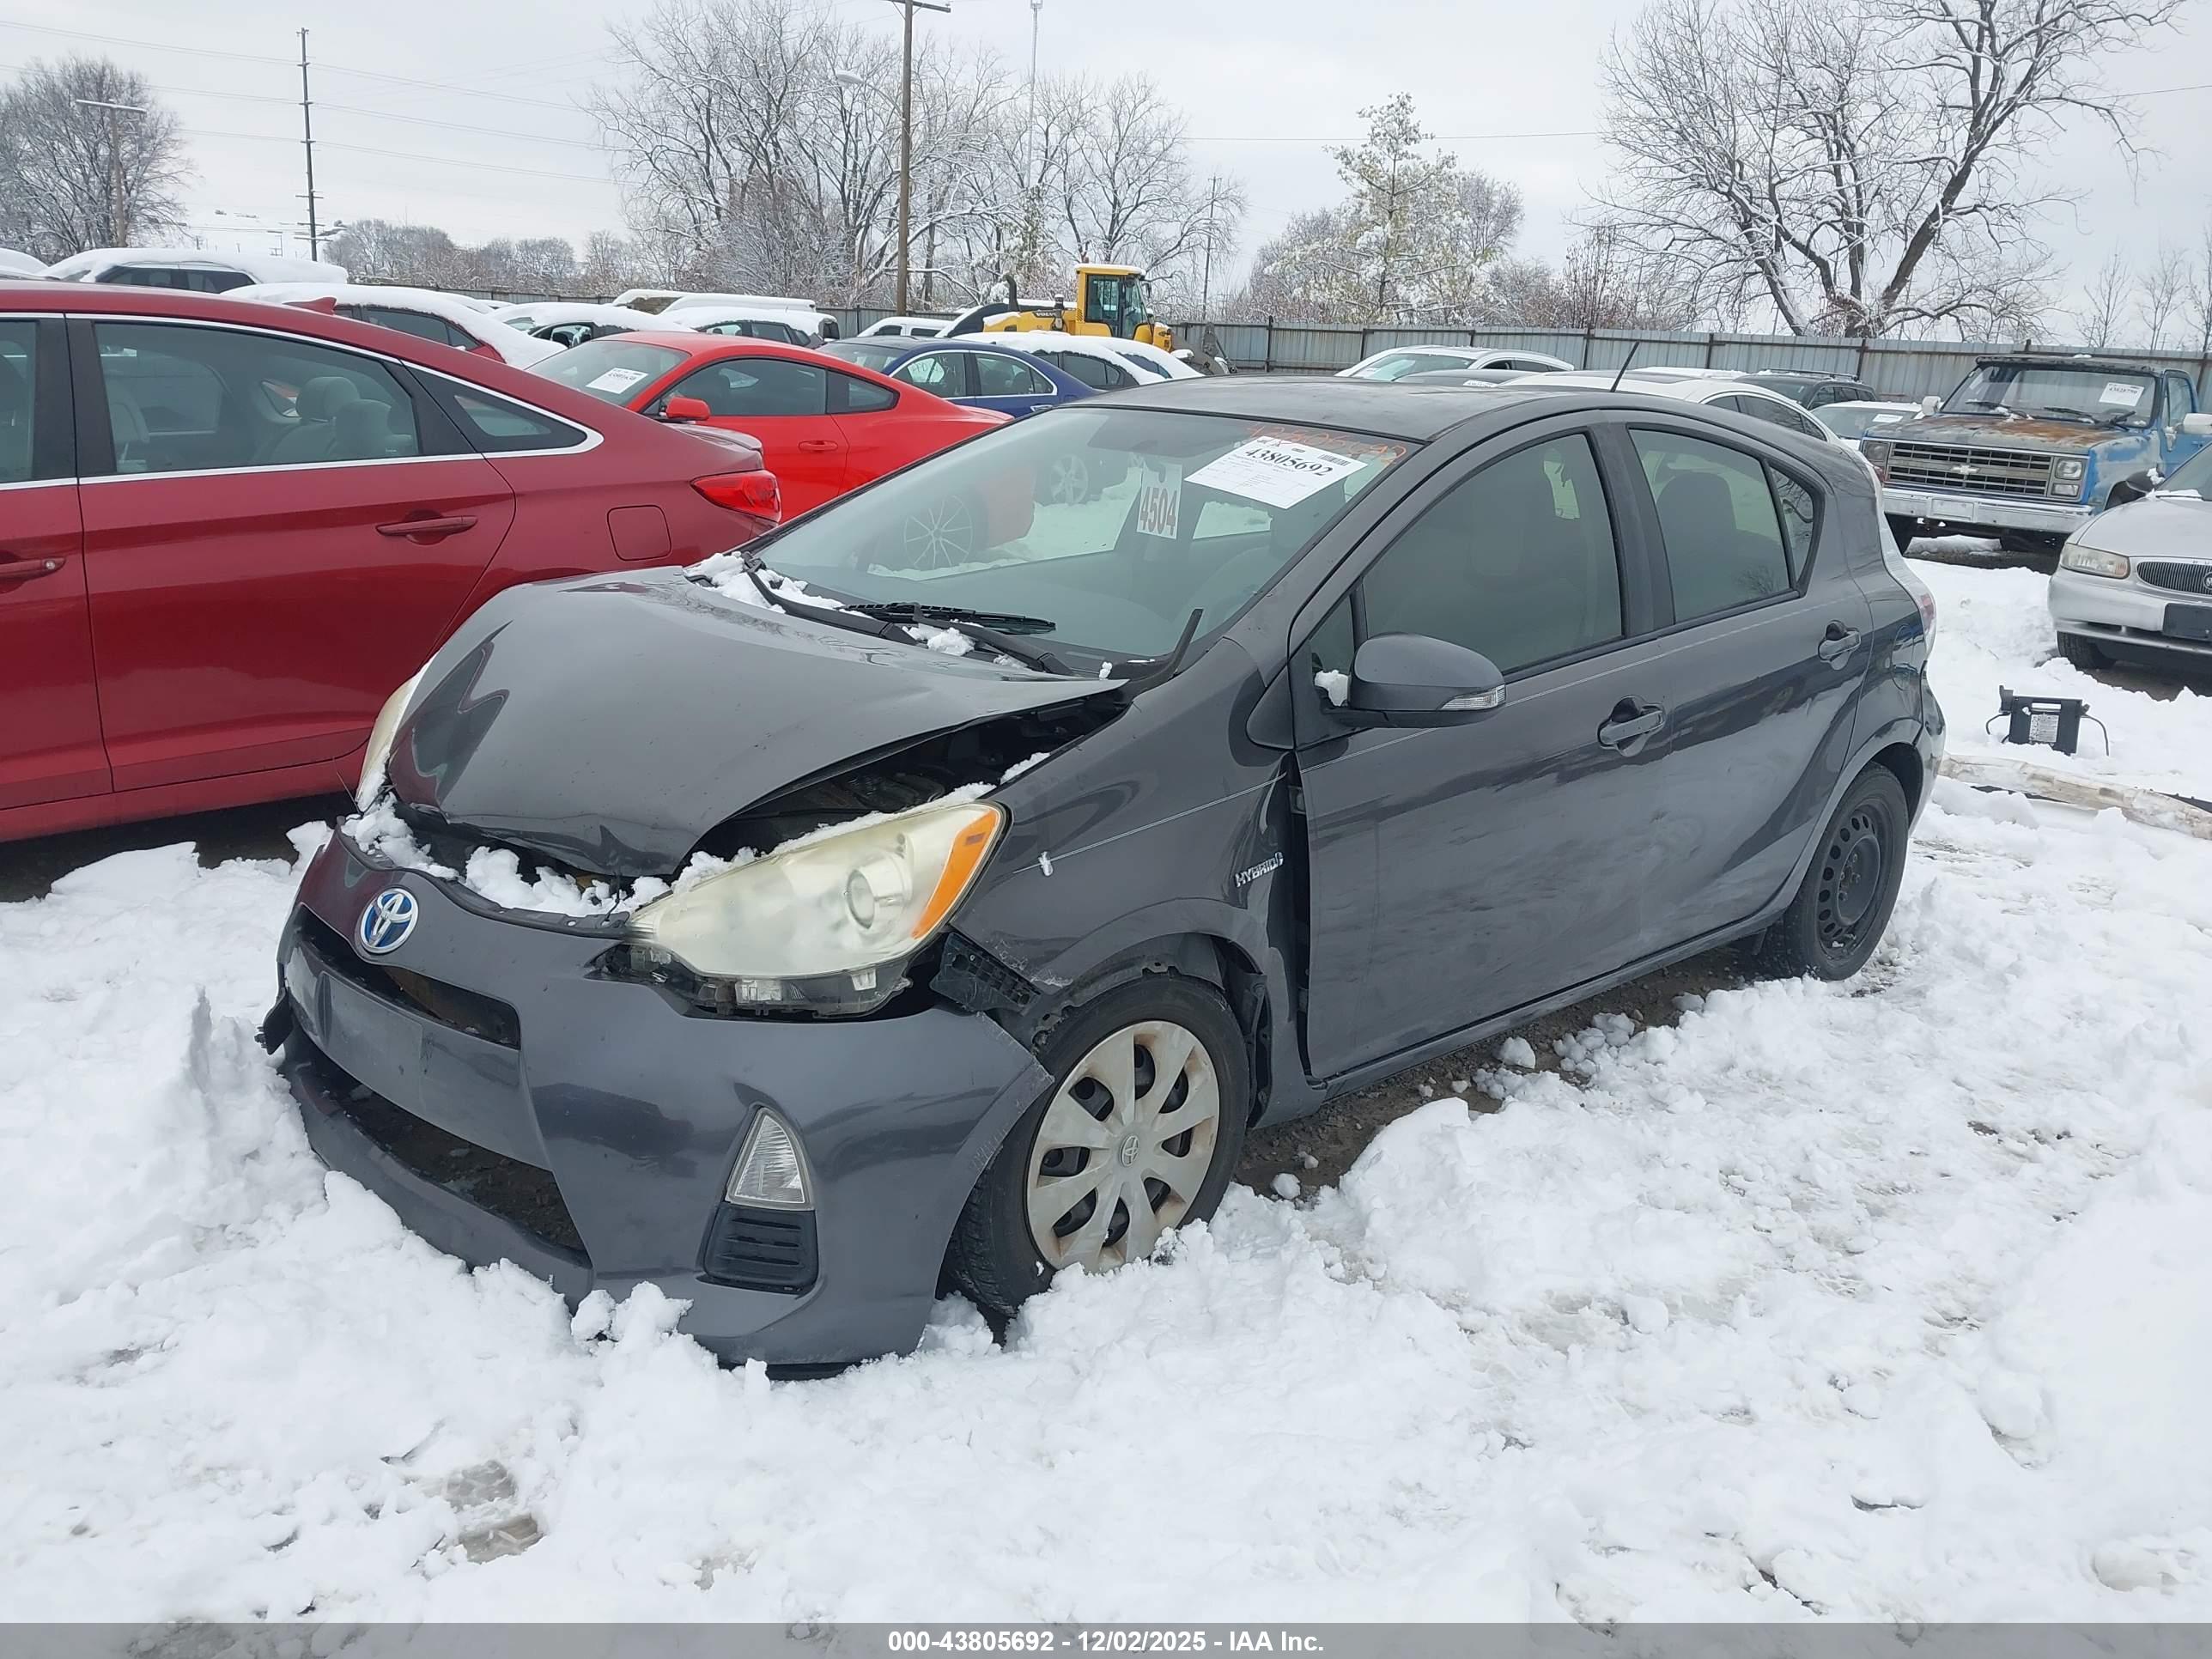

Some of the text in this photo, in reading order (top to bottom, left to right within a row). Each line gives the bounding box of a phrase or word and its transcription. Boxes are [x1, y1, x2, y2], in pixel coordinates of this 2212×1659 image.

[1245, 448, 1333, 476] 43805692
[1140, 487, 1177, 536] 4504
[1235, 857, 1279, 887] HYBRID
